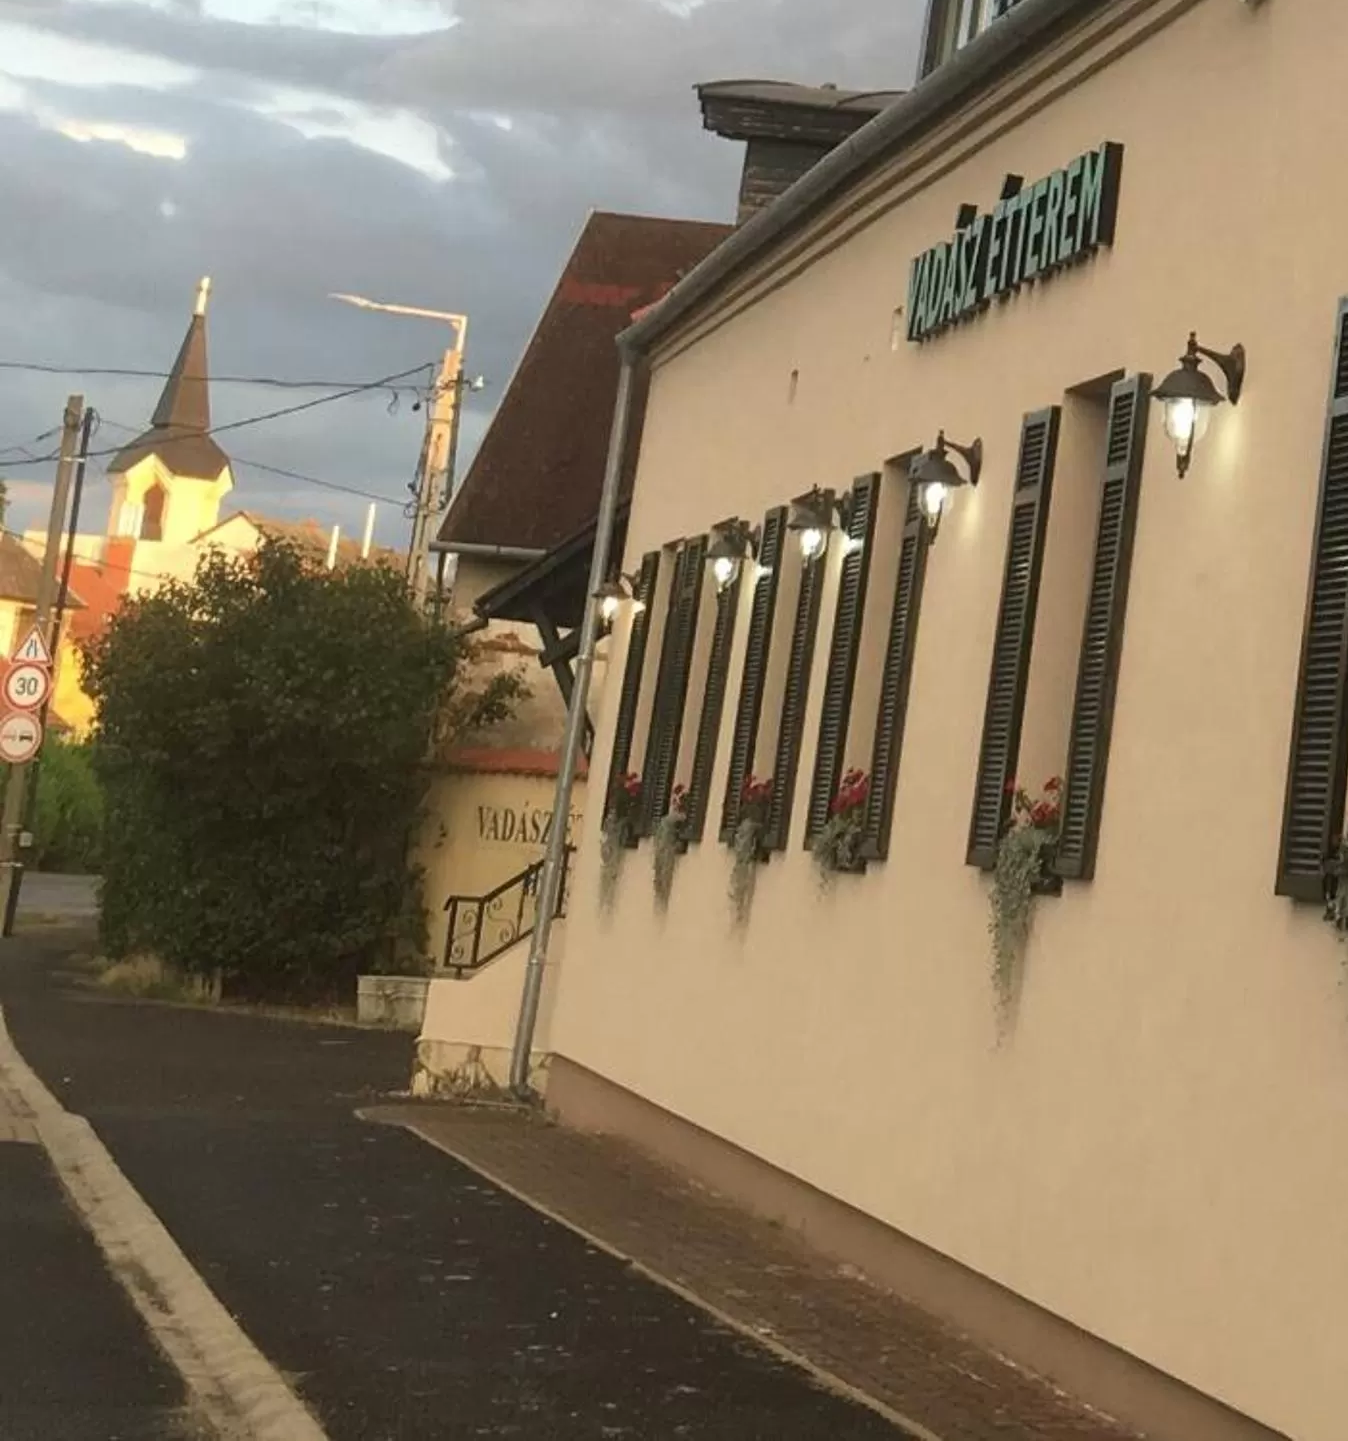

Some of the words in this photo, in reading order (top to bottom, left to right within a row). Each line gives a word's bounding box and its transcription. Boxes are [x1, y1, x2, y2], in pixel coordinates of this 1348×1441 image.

[907, 203, 988, 341] VADÁSZ
[984, 141, 1114, 298] ÉTTEREM
[15, 676, 38, 696] 30
